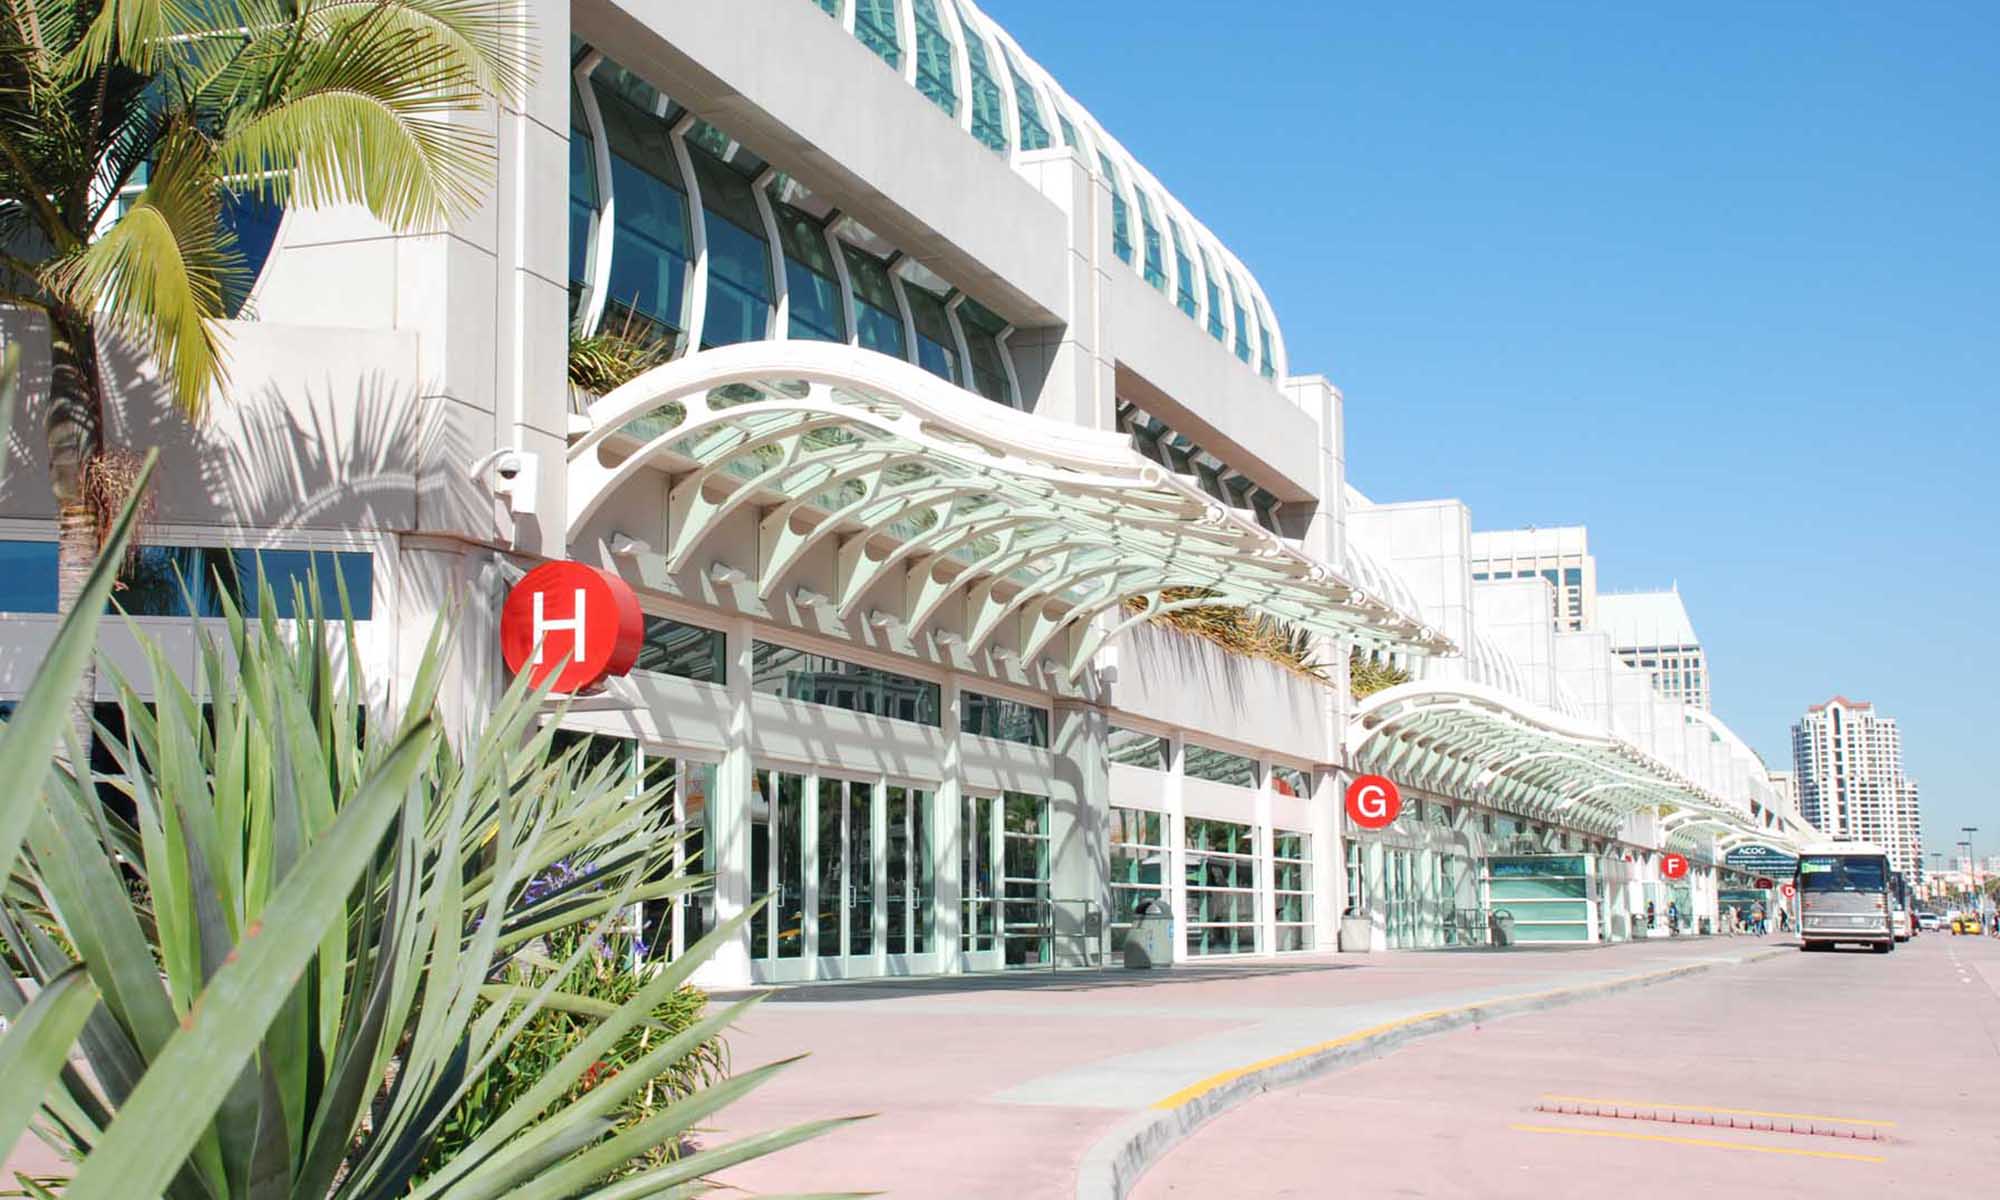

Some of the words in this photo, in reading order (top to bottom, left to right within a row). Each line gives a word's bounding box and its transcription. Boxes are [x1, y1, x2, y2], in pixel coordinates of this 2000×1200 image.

[532, 588, 586, 664] H
[1358, 785, 1386, 818] G
[1738, 847, 1766, 855] ACOG
[1668, 858, 1680, 875] F
